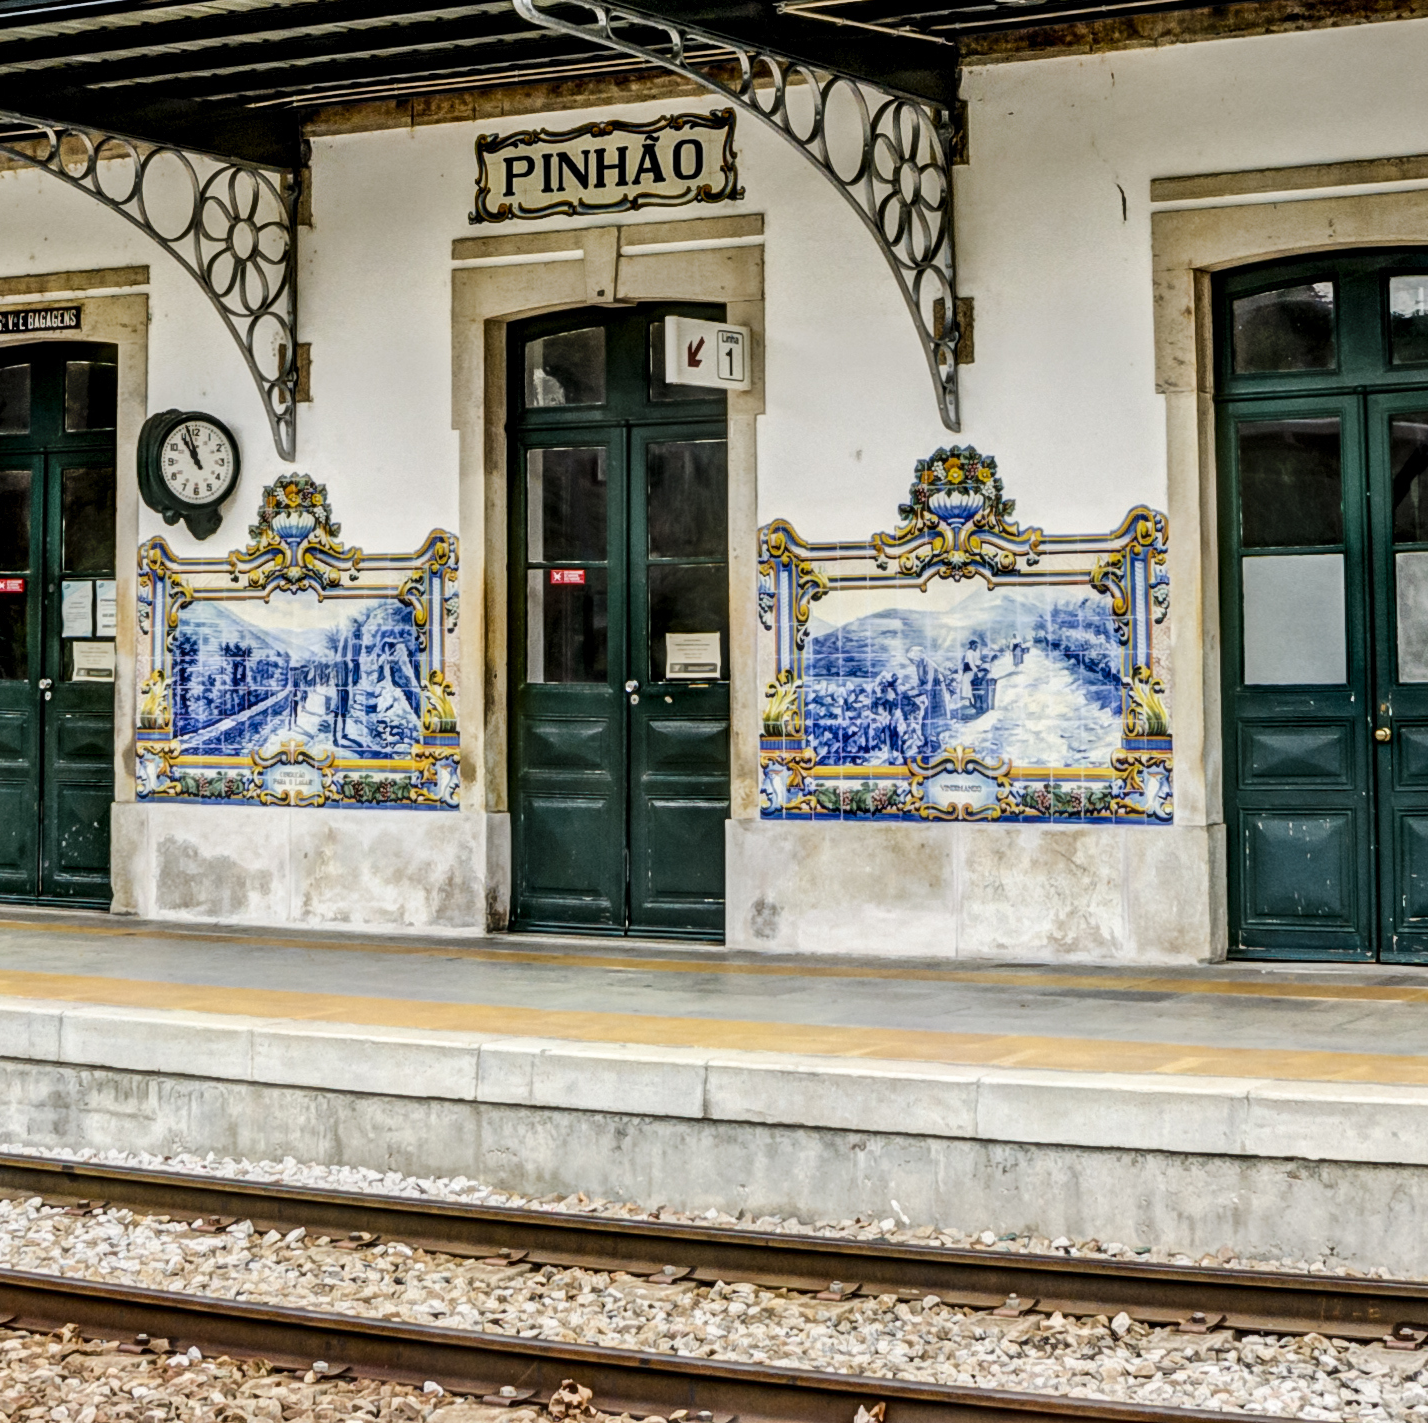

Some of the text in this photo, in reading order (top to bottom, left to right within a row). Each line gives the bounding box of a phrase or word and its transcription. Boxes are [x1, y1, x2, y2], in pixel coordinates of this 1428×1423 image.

[503, 134, 704, 197] PINHÃO
[19, 313, 26, 329] E
[28, 310, 77, 329] BAGAGENS
[722, 333, 739, 345] Linha
[725, 347, 733, 377] 1
[192, 428, 200, 436] 12
[170, 443, 178, 451] 10
[216, 443, 222, 452] 2
[167, 458, 174, 466] 9
[215, 473, 221, 481] 4
[181, 483, 187, 491] 7
[193, 487, 199, 495] 6
[206, 483, 212, 491] 5
